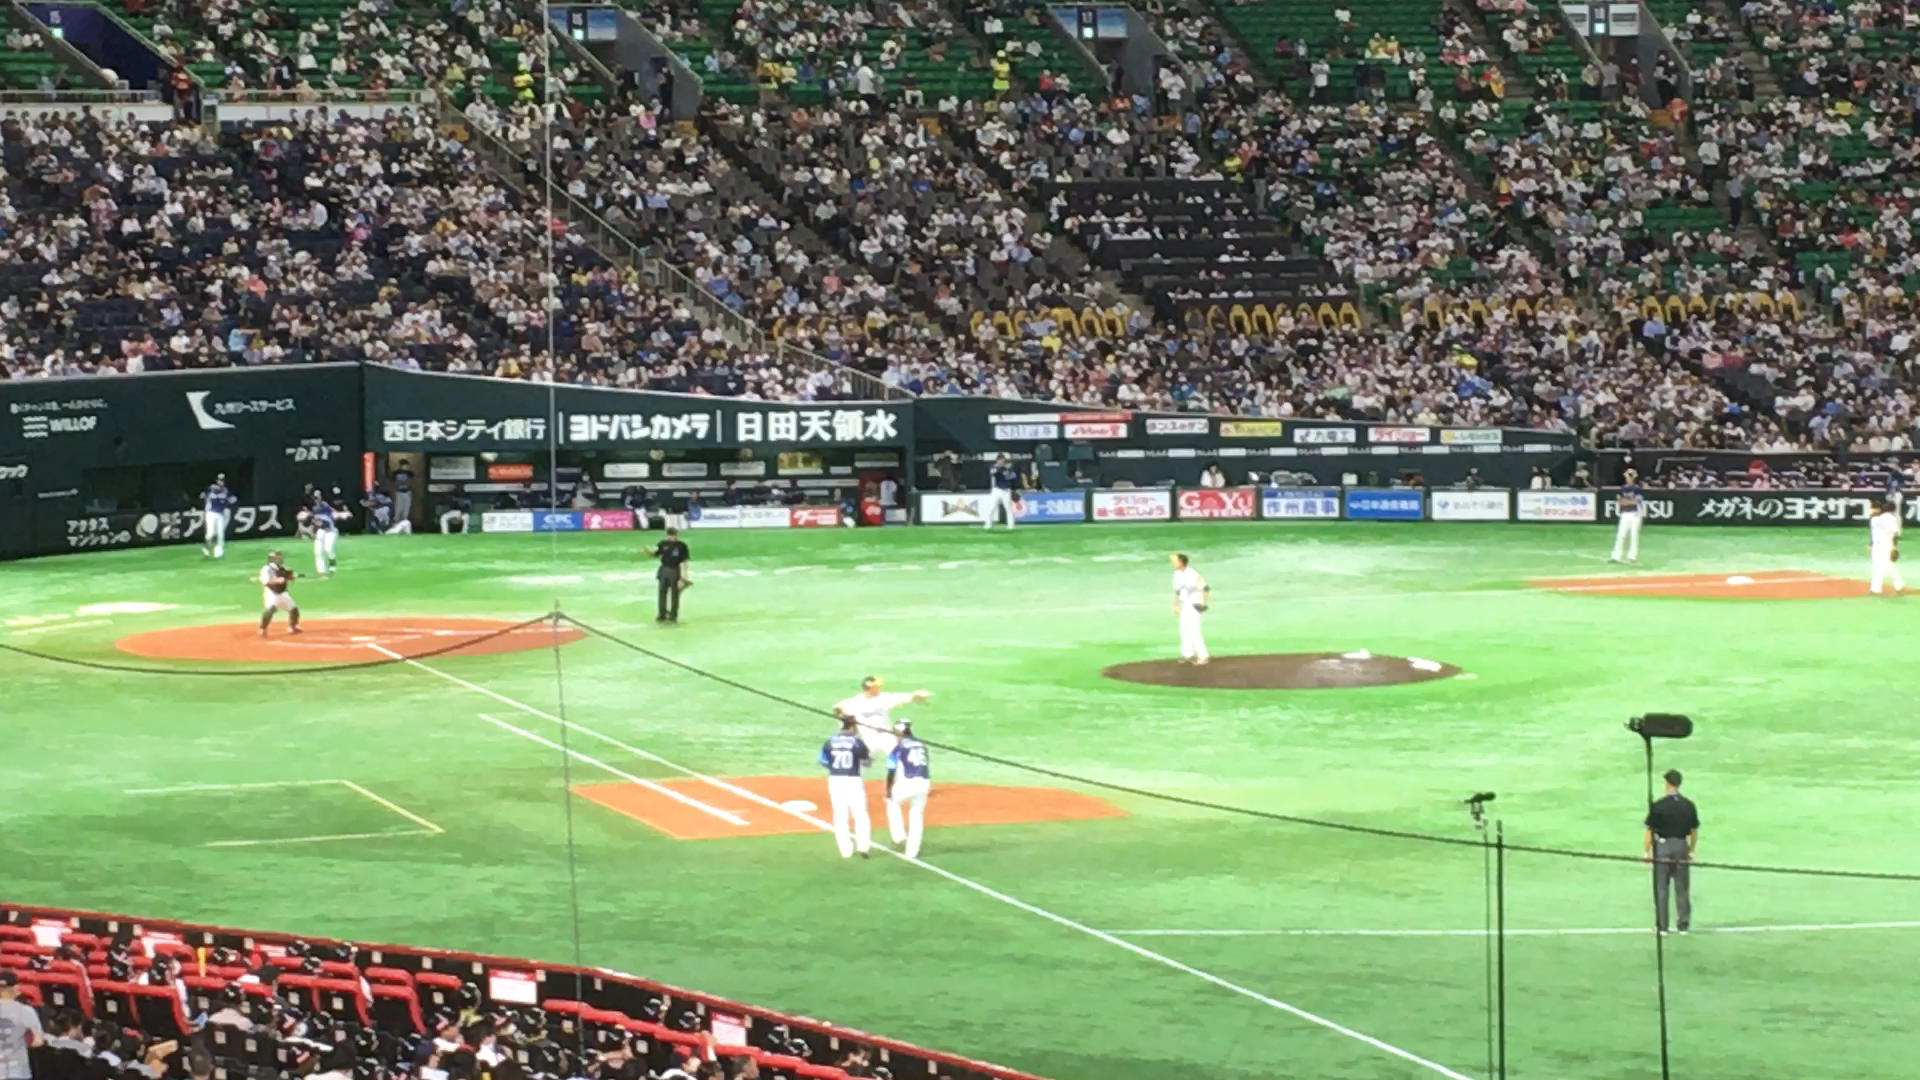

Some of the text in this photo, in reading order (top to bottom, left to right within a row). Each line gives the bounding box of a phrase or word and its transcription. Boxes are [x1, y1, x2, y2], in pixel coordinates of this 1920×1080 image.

[382, 418, 547, 441] 西日本シティ銀行
[569, 414, 711, 441] ヨドバシカメラ
[736, 409, 898, 442] 日田天領水
[183, 505, 282, 537] アタス
[1604, 500, 1675, 518] FTSU
[831, 750, 853, 769] 70
